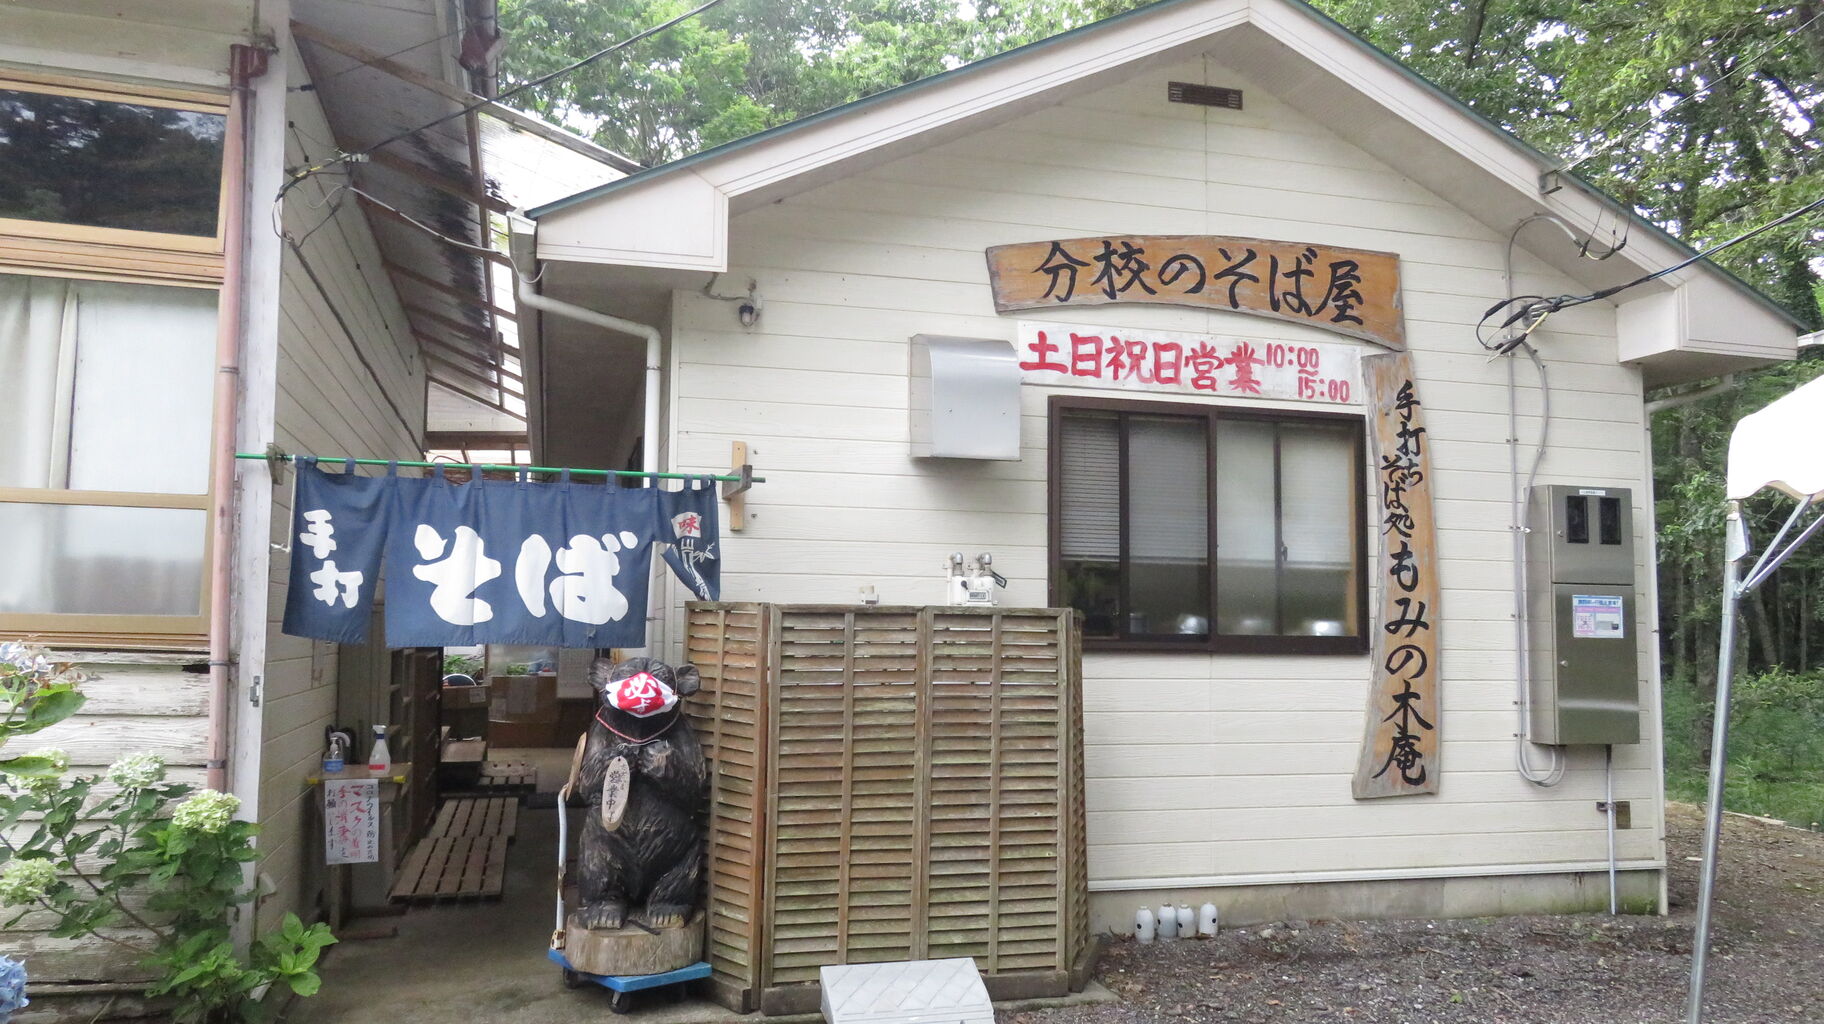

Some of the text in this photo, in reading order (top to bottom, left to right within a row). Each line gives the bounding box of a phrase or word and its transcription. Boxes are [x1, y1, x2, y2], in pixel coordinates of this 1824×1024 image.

[1031, 241, 1364, 325] 分校のそば屋
[1019, 330, 1320, 395] 土日祝日営業 10:00
[1298, 376, 1350, 403] 15:00
[299, 509, 363, 608] 手打
[678, 514, 700, 534] 味
[412, 524, 638, 626] そば
